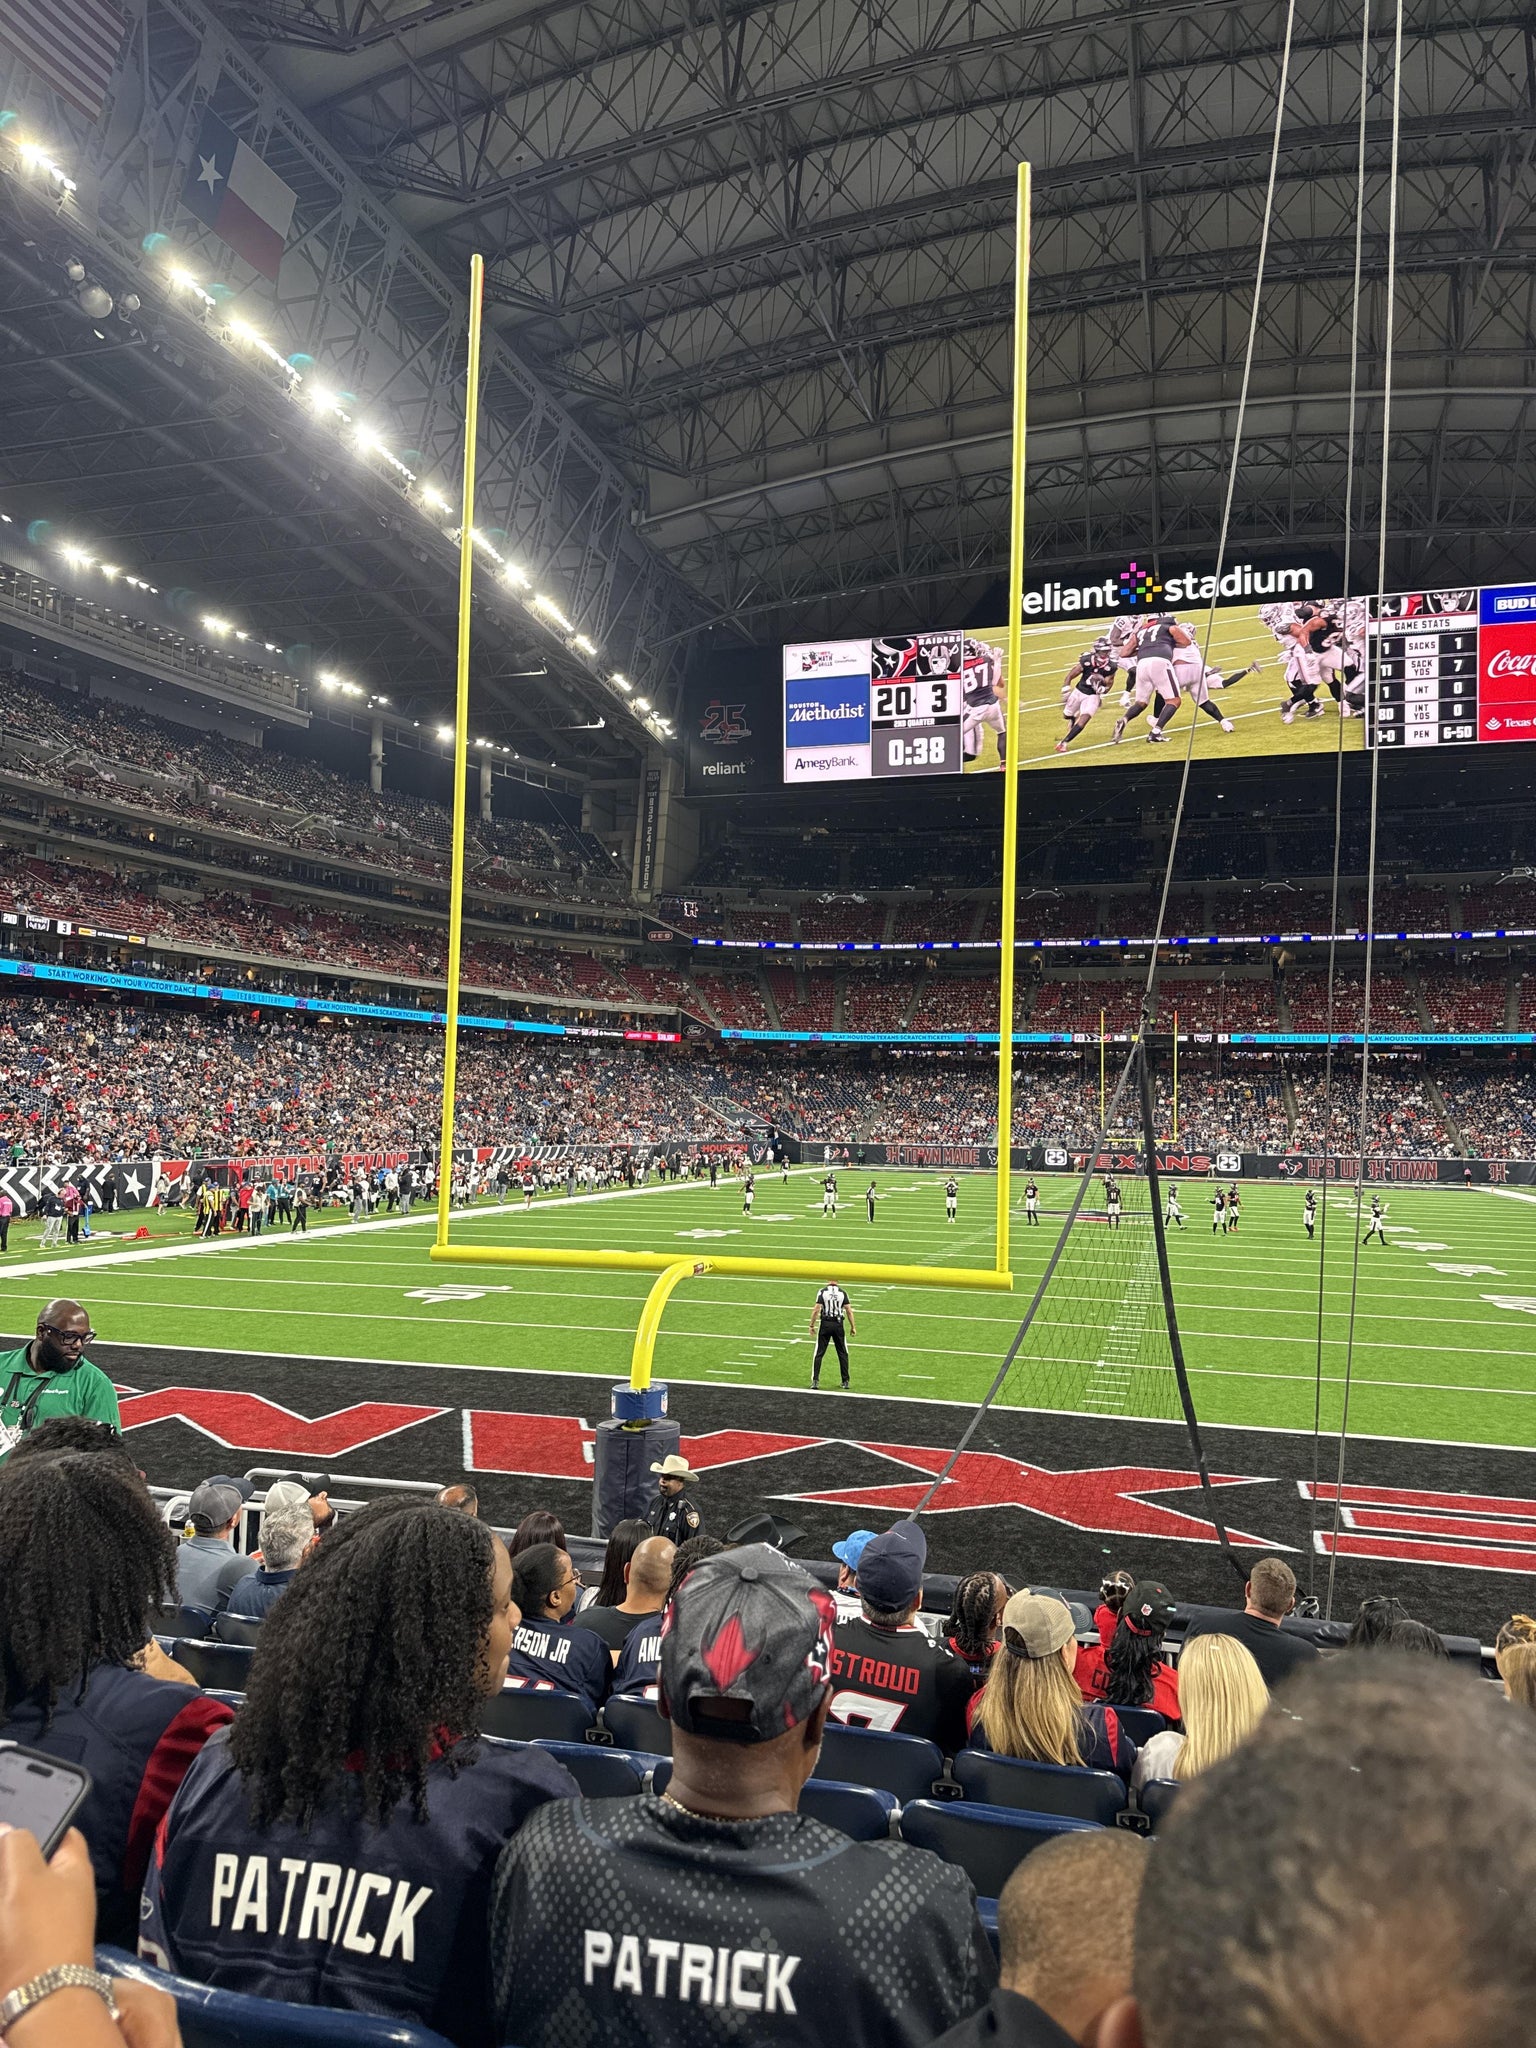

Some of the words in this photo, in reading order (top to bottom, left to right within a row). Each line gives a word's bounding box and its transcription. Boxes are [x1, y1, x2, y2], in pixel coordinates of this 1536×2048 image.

[1021, 579, 1120, 615] eliant
[1164, 564, 1314, 602] stadium
[1497, 597, 1527, 610] BUD
[1394, 621, 1418, 631] GAME
[1422, 619, 1450, 629] STATS
[918, 636, 961, 646] RAIDERS
[1408, 641, 1436, 651] SACKS
[1454, 637, 1462, 650] 1
[1383, 642, 1390, 655] 1
[1411, 660, 1433, 668] SACK
[1453, 659, 1464, 672] 7
[1414, 668, 1430, 676] YDS
[1383, 686, 1390, 699] 1
[1415, 686, 1429, 694] INT
[877, 686, 912, 716] 20
[931, 683, 948, 713] 3
[789, 703, 865, 722] Methodist
[1415, 704, 1429, 712] INT
[1414, 712, 1430, 720] YDS
[1504, 718, 1531, 728] Texas
[1414, 730, 1429, 738] PEN
[1443, 726, 1472, 739] 6-50
[888, 736, 945, 766] 0:38
[702, 762, 747, 776] reliant
[48, 969, 70, 978] START
[73, 972, 109, 984] WORKING
[110, 977, 121, 985] ON
[122, 978, 143, 988] YOUR
[144, 981, 173, 991] VICTORY
[332, 1003, 357, 1012] HOUSTON
[359, 1006, 379, 1014] TEXANS
[686, 1026, 704, 1035] Ford
[942, 1147, 980, 1165] MADE
[1389, 1160, 1438, 1180] TOWN
[550, 1638, 571, 1664] JR
[831, 1648, 920, 1695] STROUD
[210, 1853, 433, 1963] PATRICK
[582, 1929, 800, 2015] PATRICK
